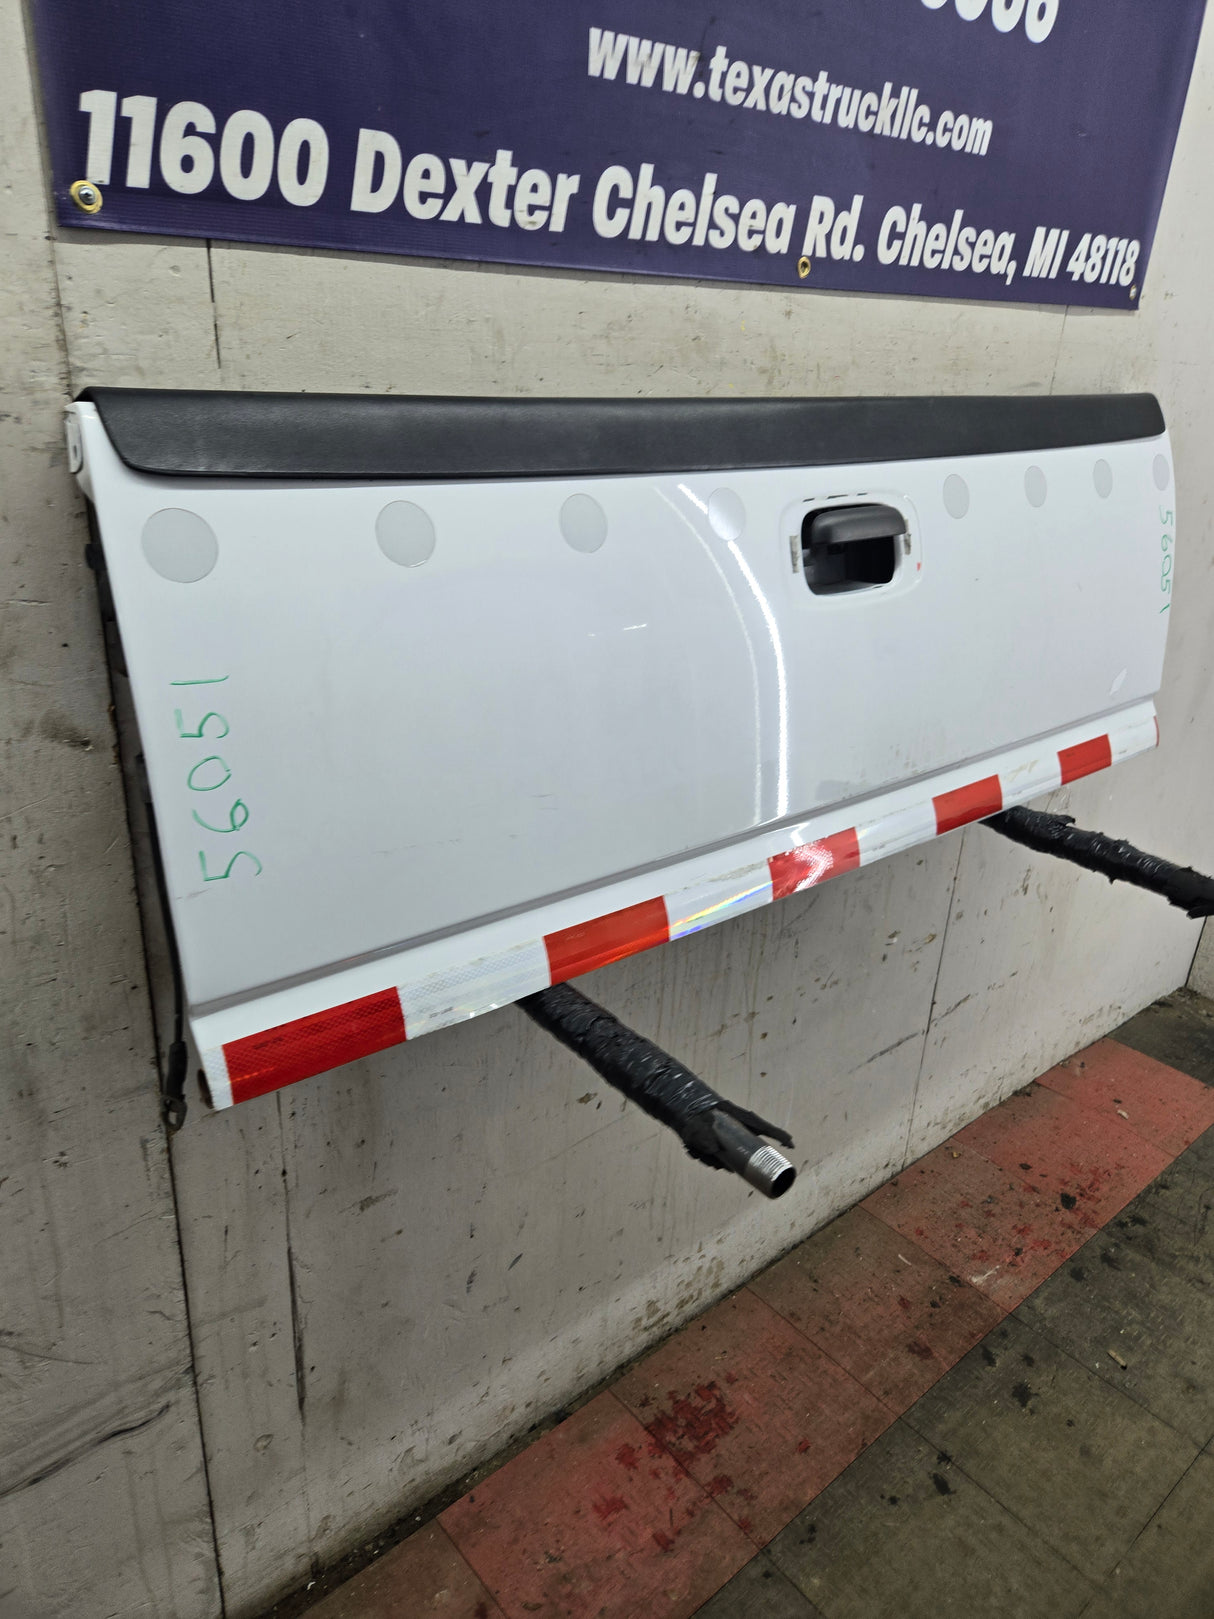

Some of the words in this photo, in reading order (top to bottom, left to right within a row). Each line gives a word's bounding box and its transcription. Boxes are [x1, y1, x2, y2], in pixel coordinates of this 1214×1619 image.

[588, 27, 993, 156] www.texastruckllc.com
[78, 89, 329, 208] 11600
[350, 128, 581, 233] Dexter
[592, 163, 797, 254] Chelsea
[801, 194, 865, 262] Rd.
[876, 203, 1017, 286] Chelsea,
[1023, 226, 1070, 279] MI
[1066, 233, 1140, 287] 48118
[1159, 505, 1174, 614] 56051
[169, 674, 263, 882] 56051
